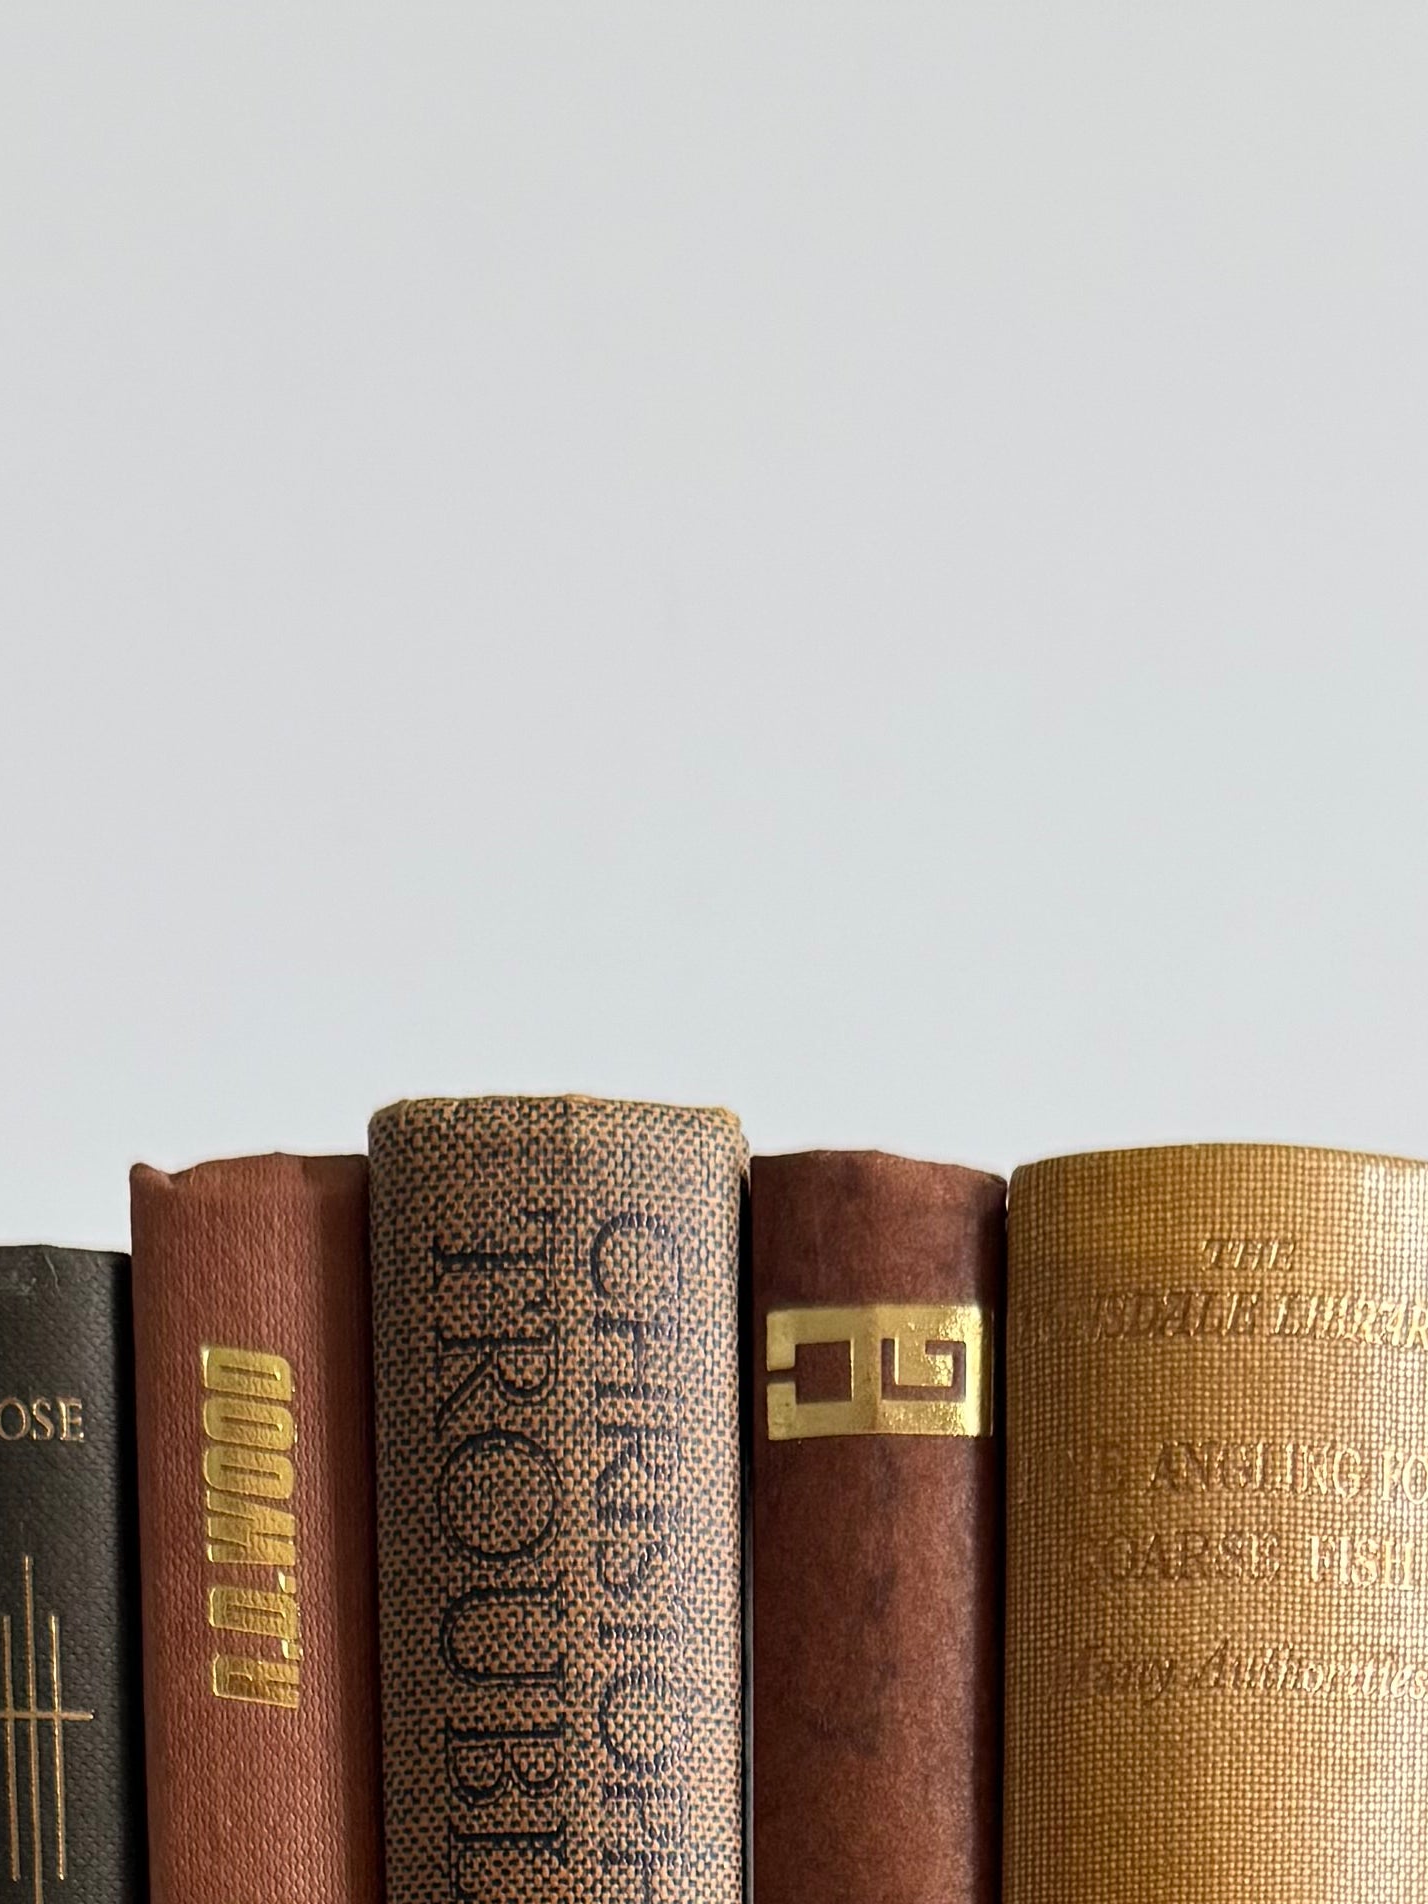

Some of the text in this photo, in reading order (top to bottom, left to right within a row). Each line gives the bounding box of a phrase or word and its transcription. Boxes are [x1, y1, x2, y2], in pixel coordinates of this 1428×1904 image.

[1201, 1237, 1296, 1272] THE
[1147, 1440, 1364, 1501] ANGLING
[1308, 1533, 1416, 1592] FISH
